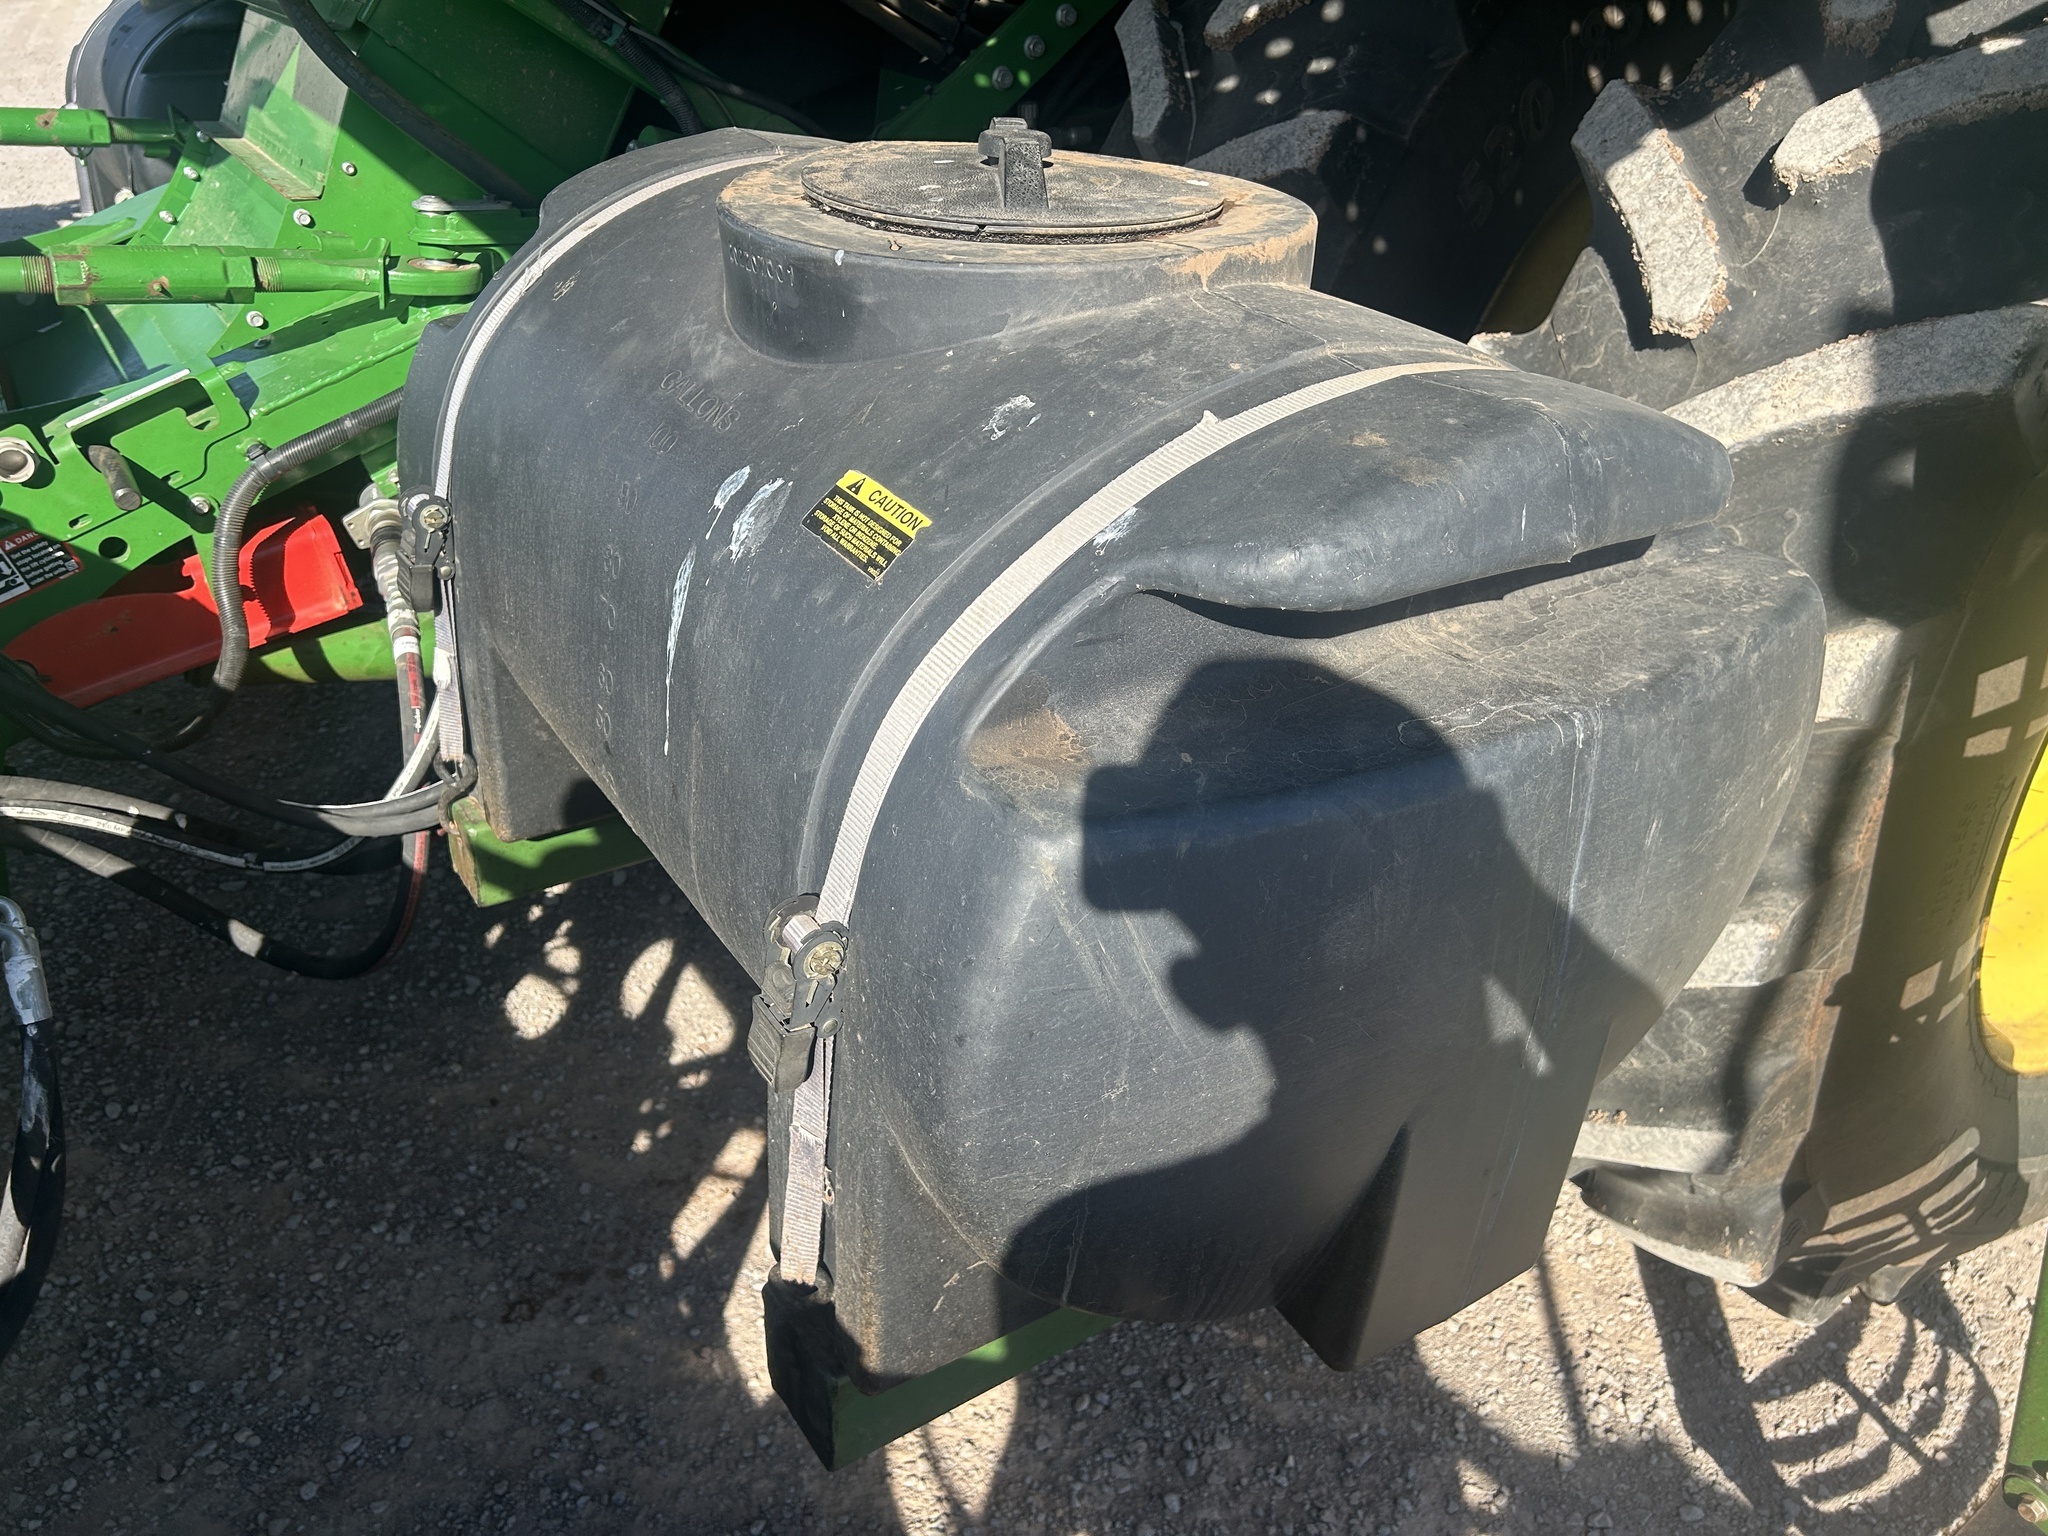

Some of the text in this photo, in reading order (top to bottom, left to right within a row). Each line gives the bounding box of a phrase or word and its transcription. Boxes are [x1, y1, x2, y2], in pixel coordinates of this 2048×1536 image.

[658, 369, 741, 434] GALLONS
[645, 420, 680, 455] 100
[820, 524, 833, 535] VOID
[830, 531, 841, 541] ALL
[823, 497, 901, 557] STORAGE OF MATERIALS CONTAINING
[832, 514, 850, 529] XYLENE
[848, 526, 857, 534] OR
[833, 495, 845, 505] THIS
[842, 502, 856, 513] TANK
[858, 513, 870, 523] NOT
[867, 520, 891, 539] DESIGNED
[889, 536, 902, 546] FOR
[867, 489, 924, 531] CAUTION
[813, 509, 835, 527] STORAGE
[838, 528, 853, 541] SUCH
[850, 537, 877, 559] MATERIALS
[874, 555, 889, 567] WILL
